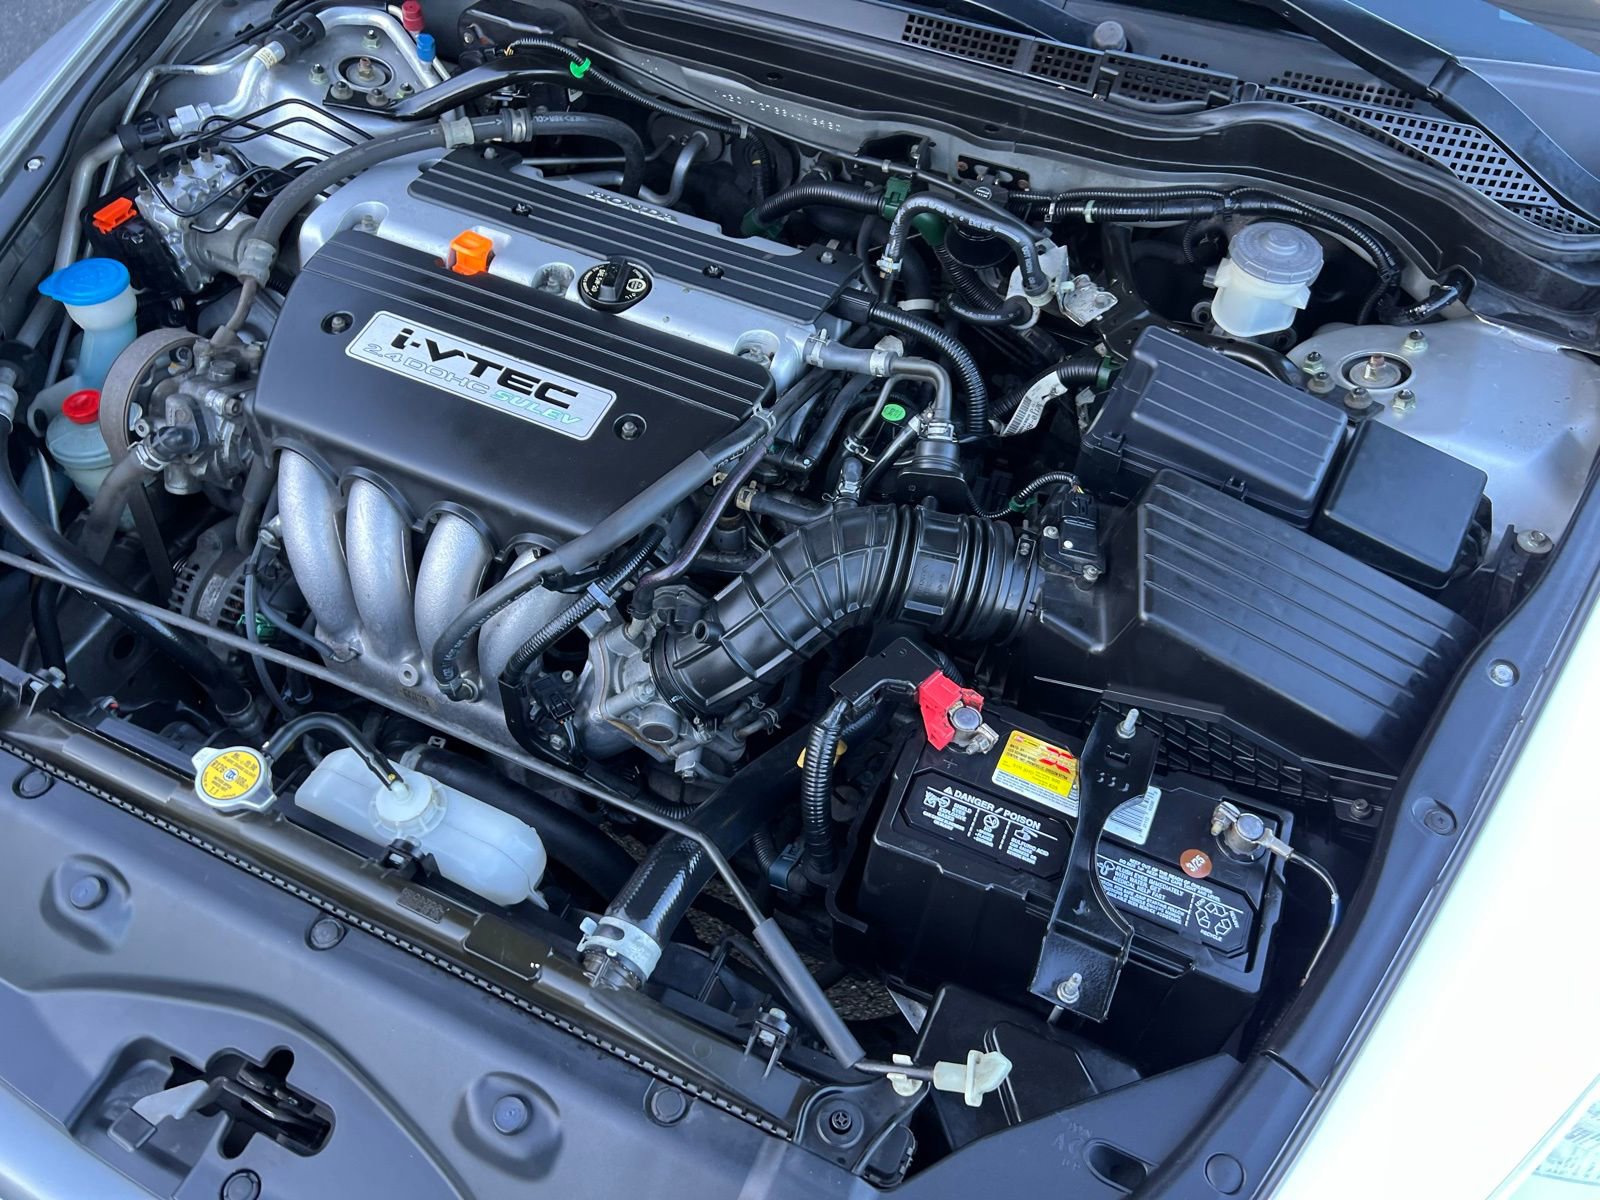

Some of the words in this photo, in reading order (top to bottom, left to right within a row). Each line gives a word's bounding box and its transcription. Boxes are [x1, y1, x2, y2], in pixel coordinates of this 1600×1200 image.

[585, 190, 678, 225] HONDA
[390, 327, 579, 409] i-VTEC
[402, 357, 491, 395] DOHC
[489, 389, 583, 426] SULEV
[953, 790, 996, 812] DANGER
[1002, 809, 1042, 830] POISON
[1184, 854, 1206, 872] 3/25
[1112, 876, 1136, 889] MEDICAL
[1136, 885, 1152, 895] HELP
[1151, 891, 1166, 900] FAST
[1114, 871, 1129, 880] WITH
[1149, 885, 1161, 893] GET
[1115, 866, 1134, 876] FLUSH
[1133, 873, 1148, 882] EYES
[1148, 879, 1185, 897] IMMEDIATELY
[1199, 929, 1223, 942] RECYCLE
